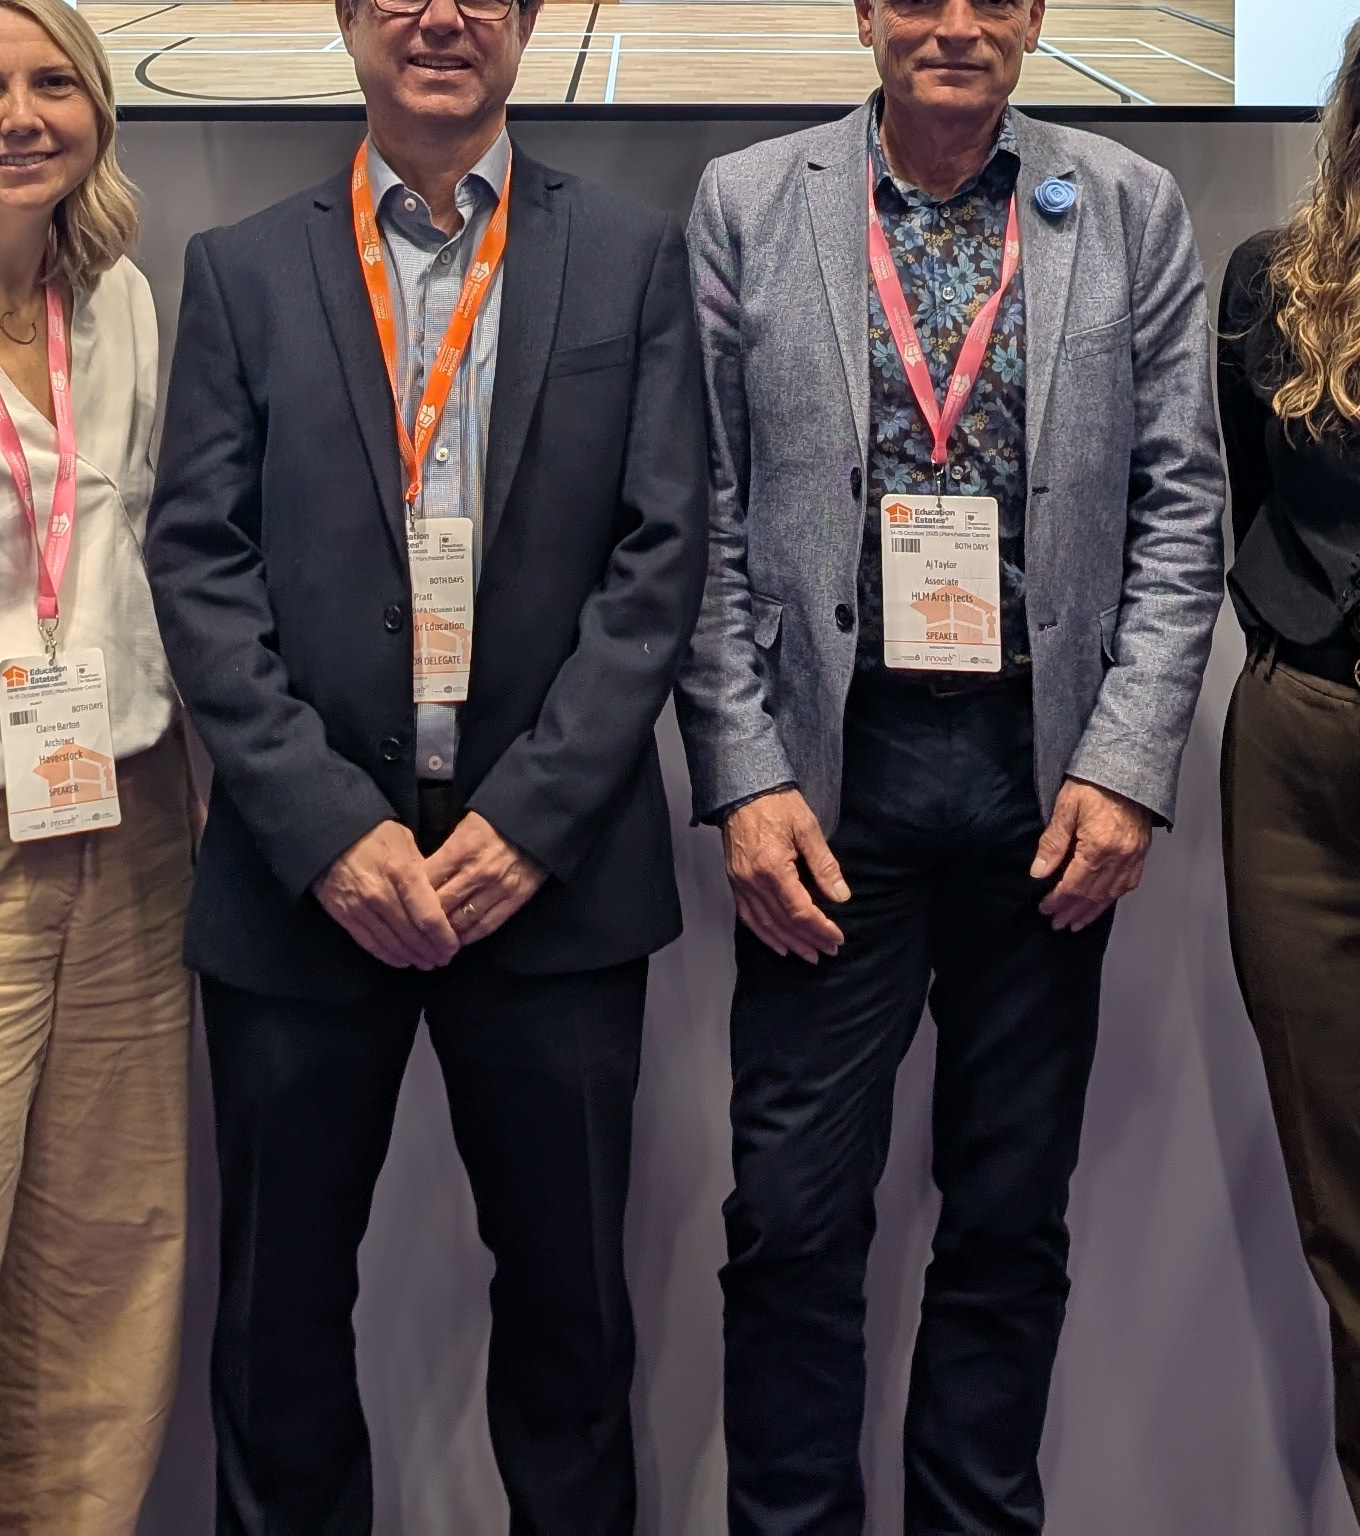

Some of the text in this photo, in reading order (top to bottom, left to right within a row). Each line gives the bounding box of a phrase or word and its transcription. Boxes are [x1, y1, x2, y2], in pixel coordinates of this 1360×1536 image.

[955, 542, 988, 551] BOTH DAYS
[935, 560, 957, 570] Taylor
[430, 577, 447, 585] BOTH
[924, 577, 959, 586] Associate
[414, 593, 432, 601] Pratt
[912, 591, 974, 603] HLM Architects
[425, 621, 465, 631] Education
[925, 632, 958, 641] SPEAKER
[424, 655, 462, 665] DELEGATE
[44, 737, 75, 748] Architect
[39, 750, 83, 765] Haverstock
[49, 784, 79, 797] SPEAKER
